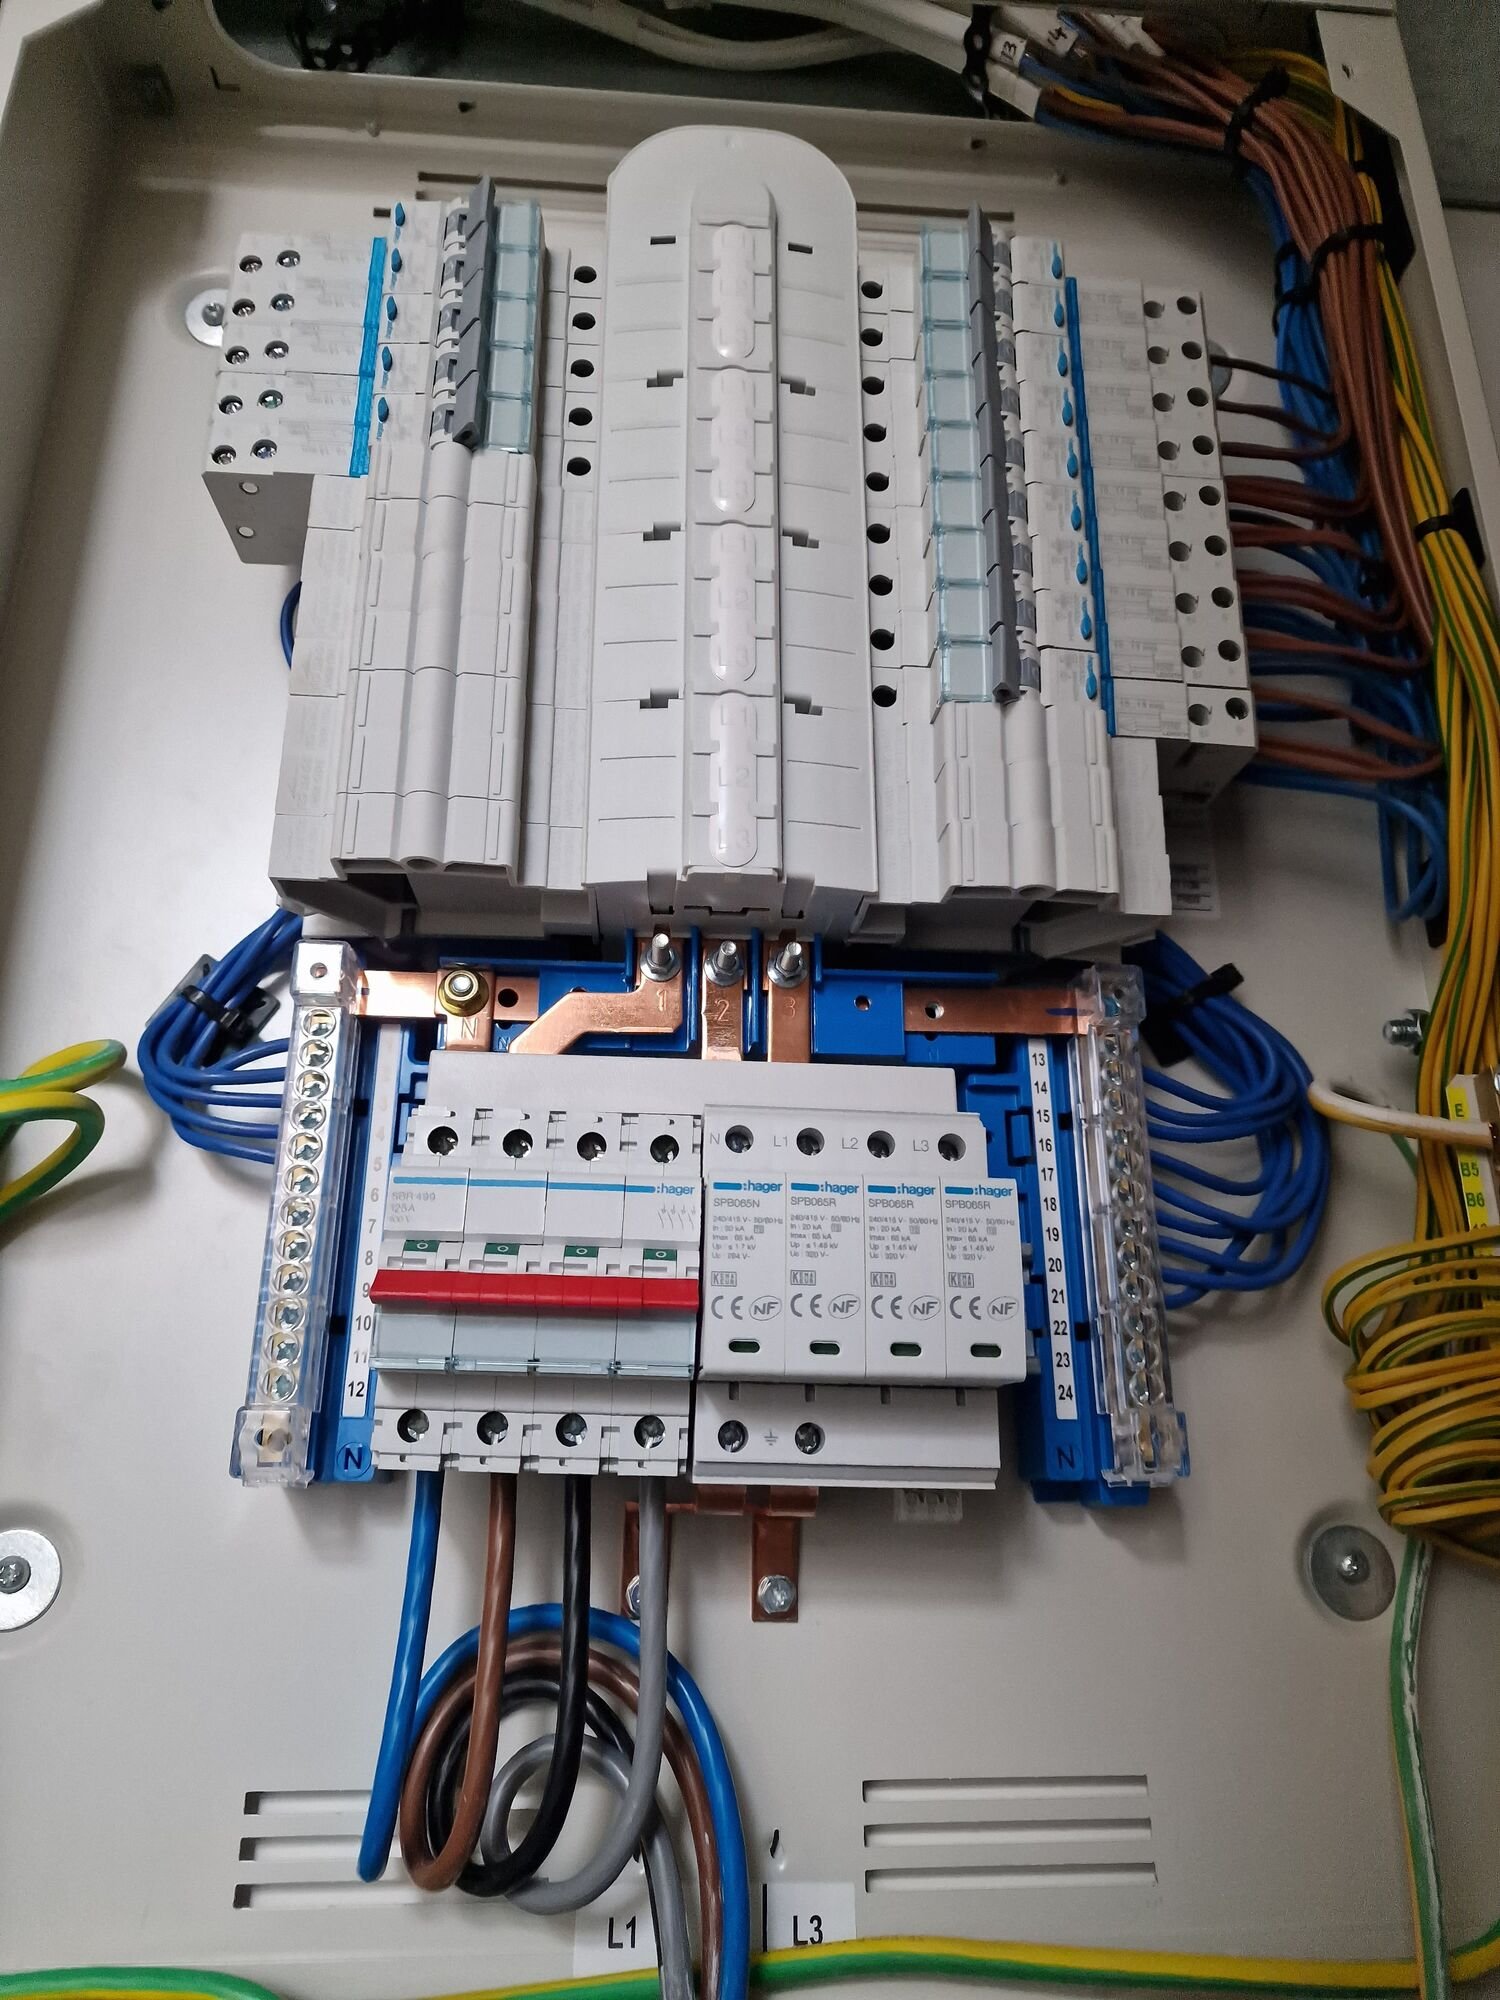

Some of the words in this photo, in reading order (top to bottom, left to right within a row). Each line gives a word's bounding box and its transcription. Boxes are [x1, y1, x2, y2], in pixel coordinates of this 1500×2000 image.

[657, 989, 667, 1012] 1
[714, 999, 730, 1023] 2
[461, 1018, 478, 1039] N
[1032, 1052, 1046, 1067] 13
[1034, 1080, 1048, 1095] 14
[1036, 1109, 1050, 1123] 15
[1455, 1103, 1464, 1118] E
[710, 1133, 720, 1145] N
[773, 1135, 788, 1147] L1
[842, 1138, 858, 1149] L2
[913, 1139, 929, 1152] L3
[1038, 1138, 1052, 1153] 16
[373, 1156, 382, 1172] 5
[1461, 1162, 1479, 1177] B5
[1041, 1167, 1054, 1182] 17
[370, 1187, 379, 1202] 6
[1466, 1192, 1485, 1208] B6
[1043, 1197, 1057, 1212] 18
[368, 1218, 377, 1234] 7
[1045, 1227, 1059, 1242] 19
[364, 1250, 373, 1266] 8
[1048, 1258, 1062, 1273] 20
[362, 1282, 370, 1298] 9
[1051, 1289, 1065, 1304] 21
[711, 1295, 743, 1320] CE
[754, 1302, 779, 1315] NF
[790, 1293, 822, 1318] CE
[832, 1300, 857, 1313] NF
[871, 1295, 903, 1320] CE
[913, 1301, 938, 1315] NF
[950, 1296, 981, 1320] CE
[992, 1302, 1016, 1315] NF
[355, 1315, 372, 1331] 10
[1053, 1320, 1068, 1336] 22
[1056, 1352, 1070, 1367] 23
[348, 1381, 365, 1397] 12
[1058, 1384, 1073, 1400] 24
[343, 1446, 362, 1471] N
[1056, 1448, 1075, 1469] N
[607, 1915, 637, 1949] L1
[792, 1914, 823, 1947] L3
